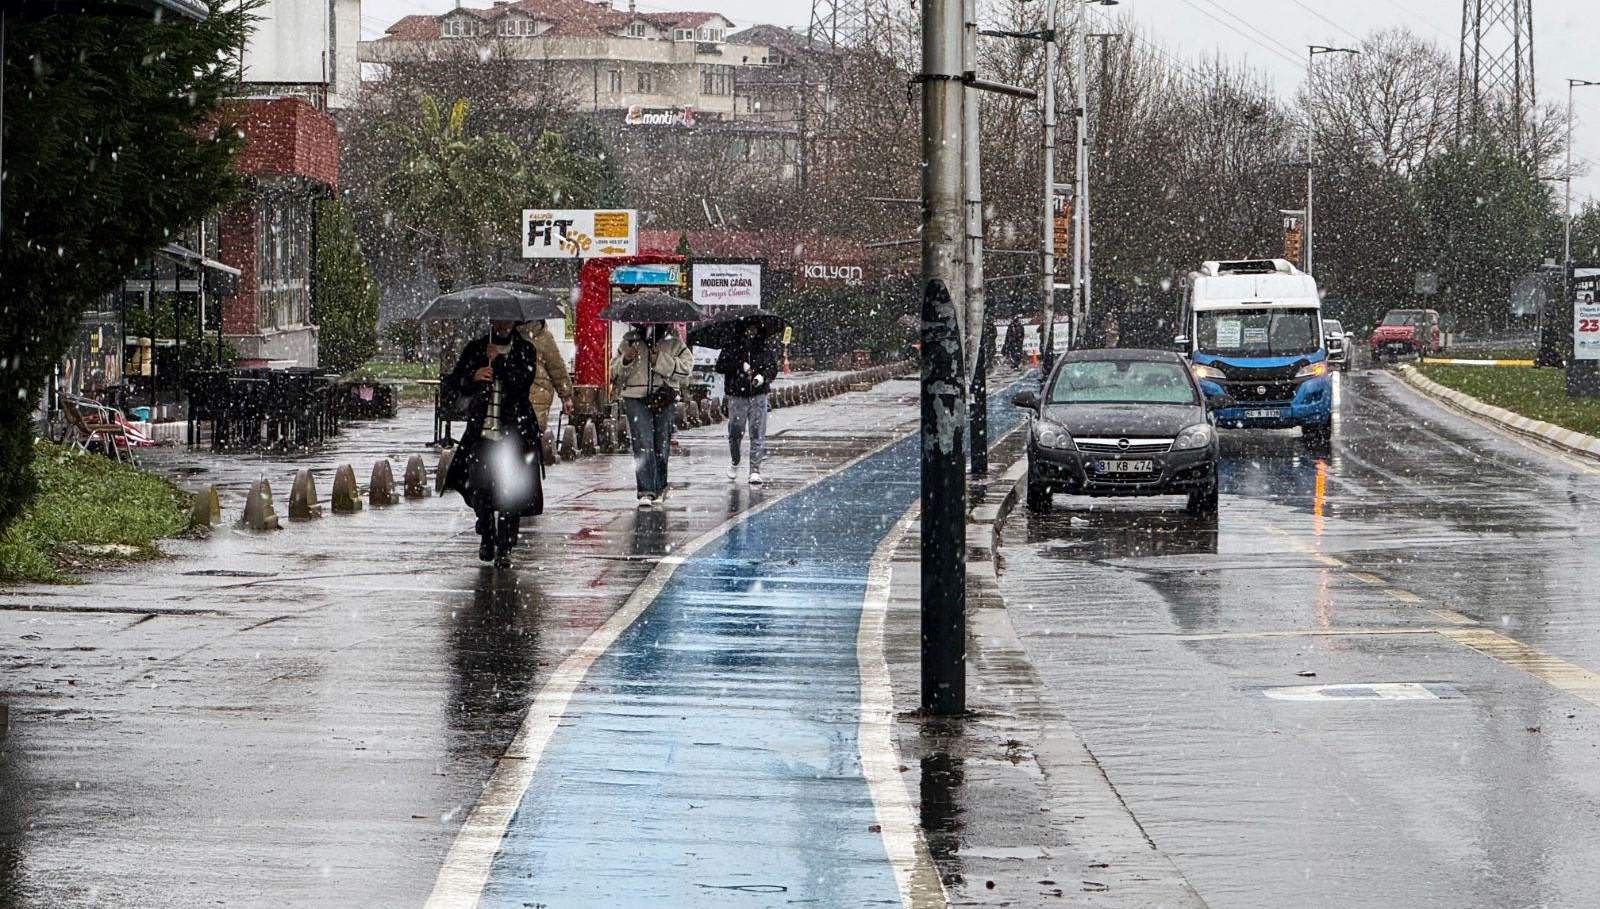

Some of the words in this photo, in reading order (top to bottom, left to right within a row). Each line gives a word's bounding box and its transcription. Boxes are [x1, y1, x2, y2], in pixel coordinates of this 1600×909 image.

[701, 278, 729, 287] MODERN
[1579, 319, 1599, 332] 23
[1100, 461, 1111, 470] 81
[1116, 461, 1129, 470] KB
[1133, 461, 1152, 470] 474
